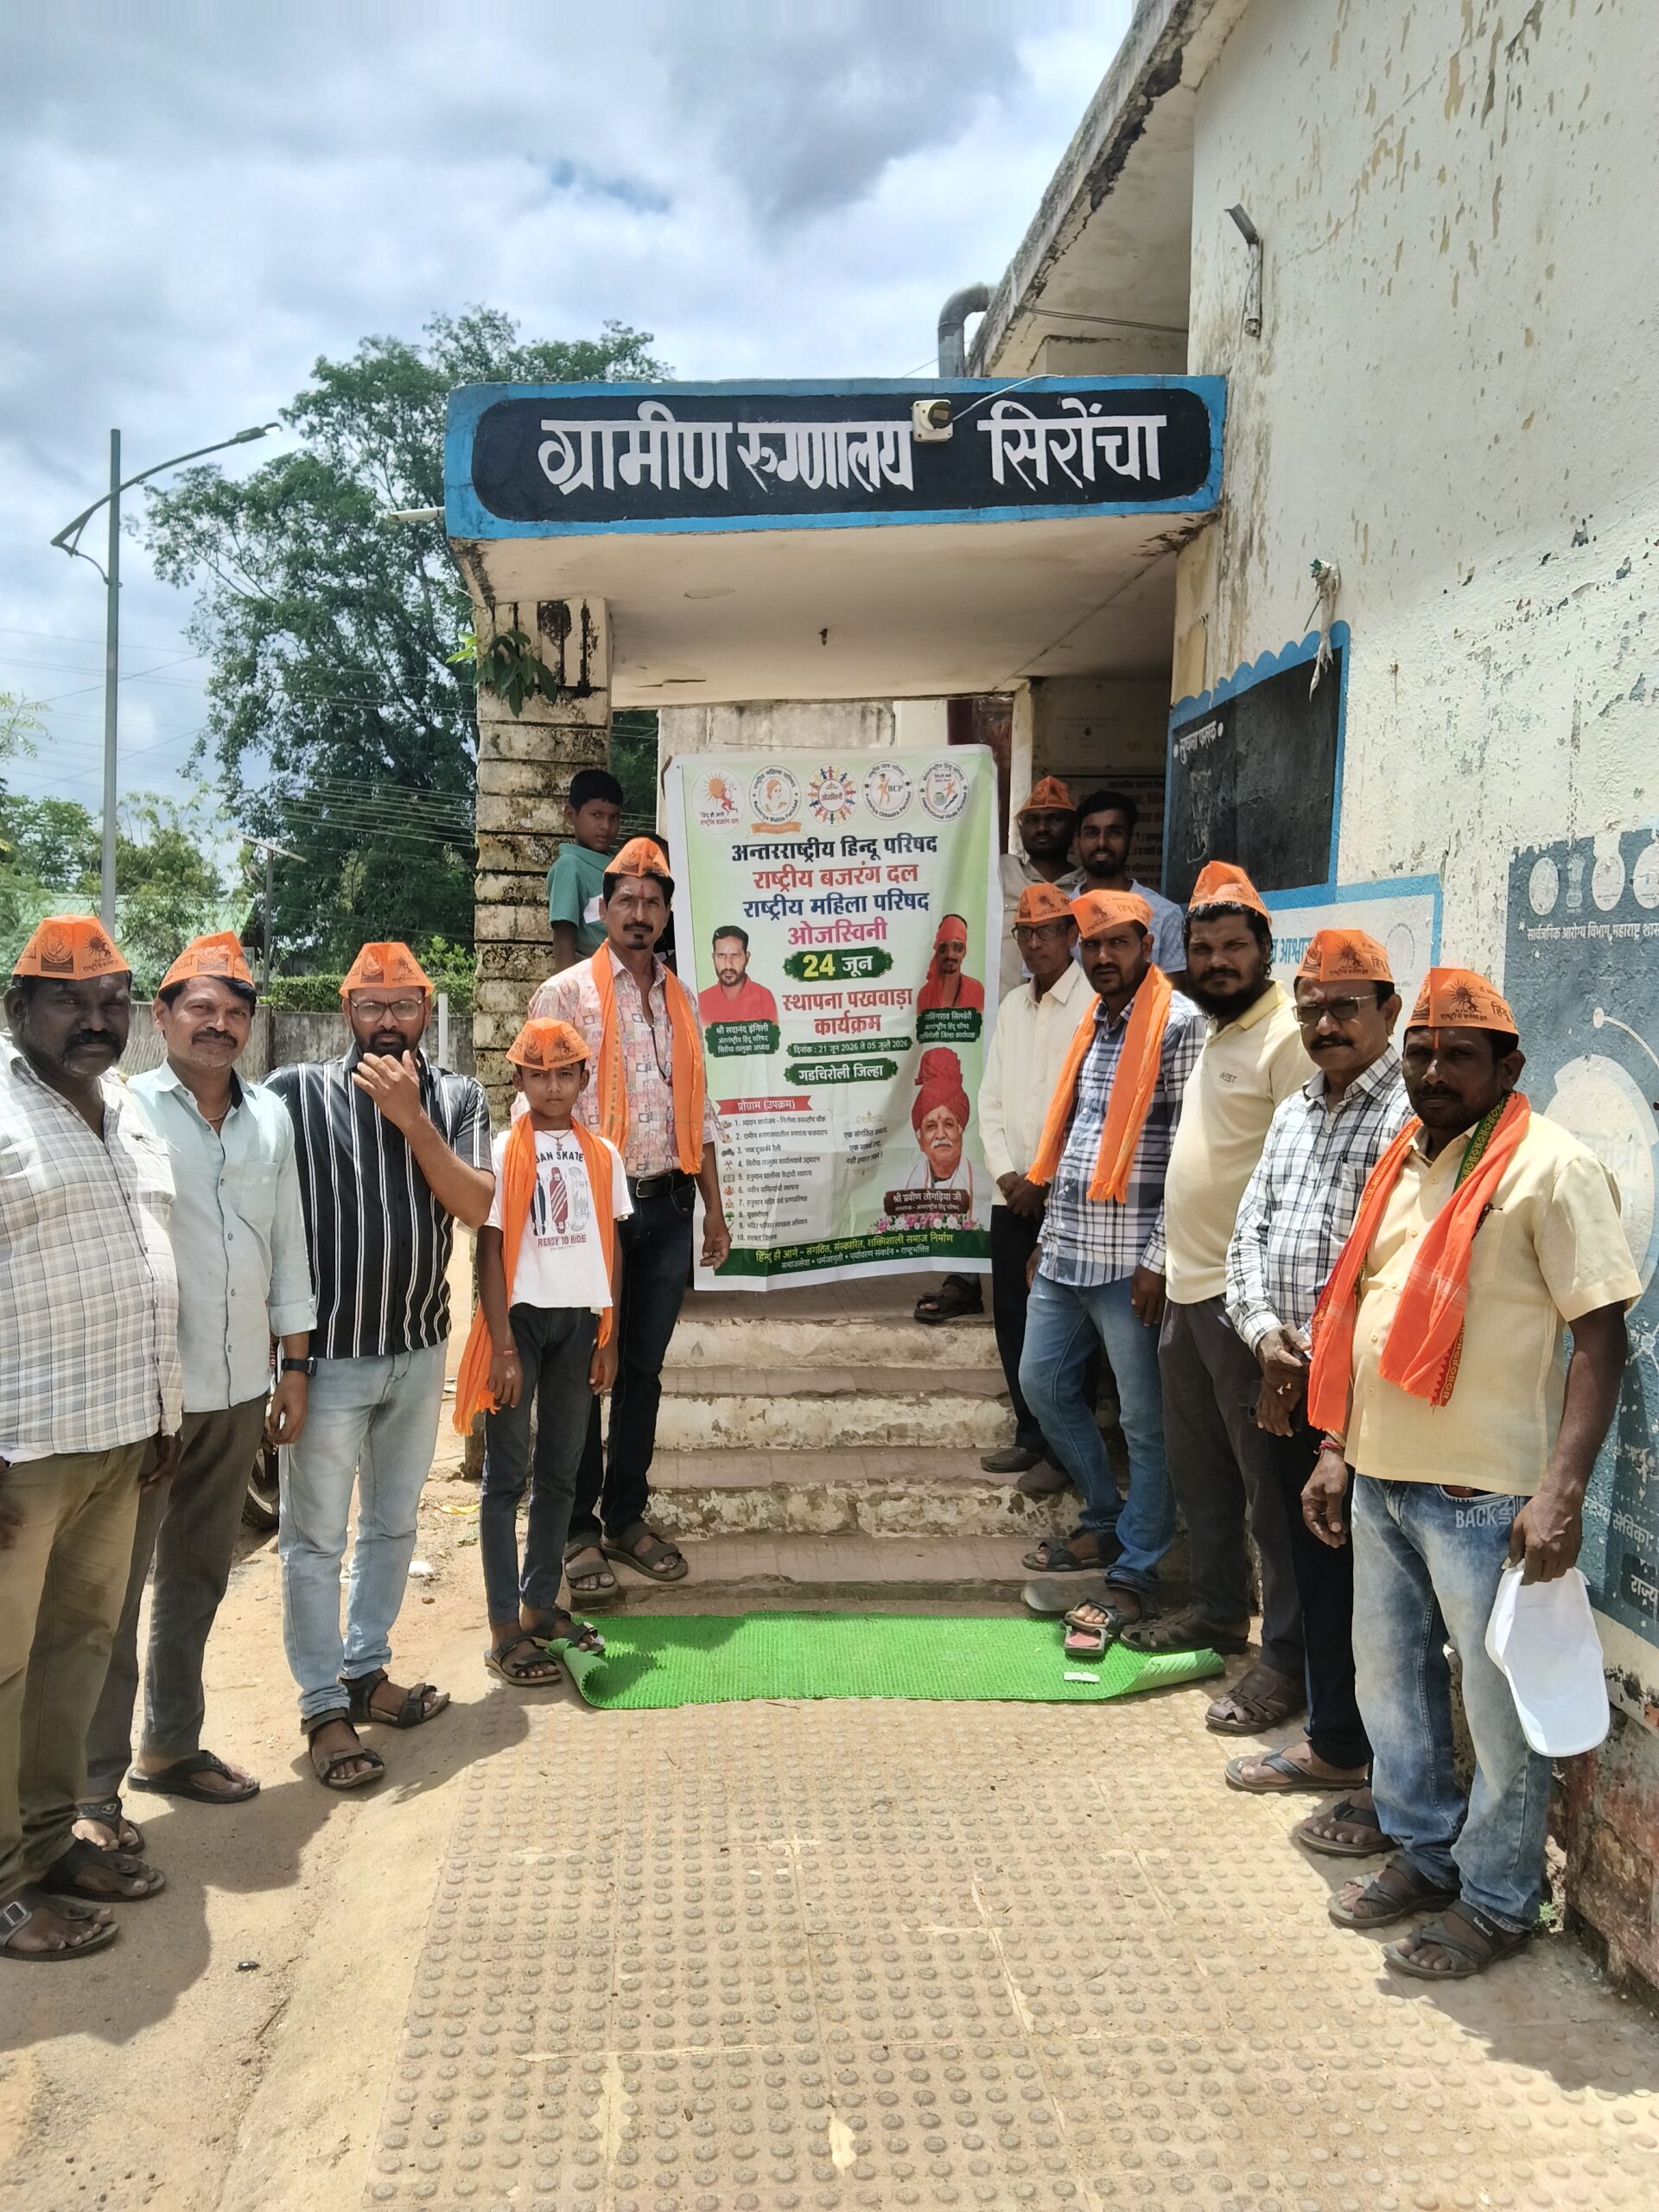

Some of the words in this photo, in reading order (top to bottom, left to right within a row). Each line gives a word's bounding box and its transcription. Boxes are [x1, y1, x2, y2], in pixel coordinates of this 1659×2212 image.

[537, 399, 733, 496] ग्रामीण
[737, 420, 915, 493] रुग्णालय
[976, 399, 1167, 492] सिरोंचा
[732, 837, 835, 862] अन्तरराष्ट्रीय
[841, 836, 880, 861] हिन्दू
[884, 832, 938, 853] परिषद
[753, 864, 813, 892] राष्ट्रीय
[819, 861, 880, 887] बजरंग
[887, 864, 919, 883] दल
[742, 893, 804, 921] राष्ट्रीय
[810, 892, 868, 915] महिला
[873, 887, 930, 911] परिषद
[787, 916, 887, 945] ओजस्विनी
[1527, 924, 1561, 941] सार्वजनिक
[1562, 922, 1586, 939] आरोग्य
[803, 953, 836, 977] 24
[842, 956, 873, 977] जून
[782, 993, 842, 1011] स्थापना
[847, 988, 912, 1010] पखवाड़ा
[814, 1010, 881, 1035] कार्यक्रम
[793, 1045, 812, 1054] दिनांक
[818, 1045, 827, 1053] 21
[829, 1045, 840, 1055] जून
[841, 1042, 858, 1052] 2026
[867, 1041, 876, 1050] 05
[893, 1039, 908, 1048] 2026
[798, 1065, 850, 1081] गडचिरोली
[853, 1063, 883, 1077] जिल्हा
[737, 1099, 760, 1111] प्रोग्राम
[764, 1099, 795, 1110] (उपक्रम)
[854, 1128, 874, 1138] संगठित
[747, 1173, 762, 1182] हनुमान
[747, 1199, 763, 1208] हनुमान
[903, 1192, 921, 1202] प्रवीण
[952, 1191, 962, 1201] जी
[537, 1236, 559, 1248] READY
[570, 1234, 587, 1244] RIDE
[773, 1249, 781, 1261] ही
[783, 1247, 798, 1259] आगे
[906, 1234, 928, 1243] समाज
[930, 1231, 954, 1243] निर्माण
[781, 1258, 810, 1269] समाजसेवा
[1455, 1505, 1498, 1529] BACK
